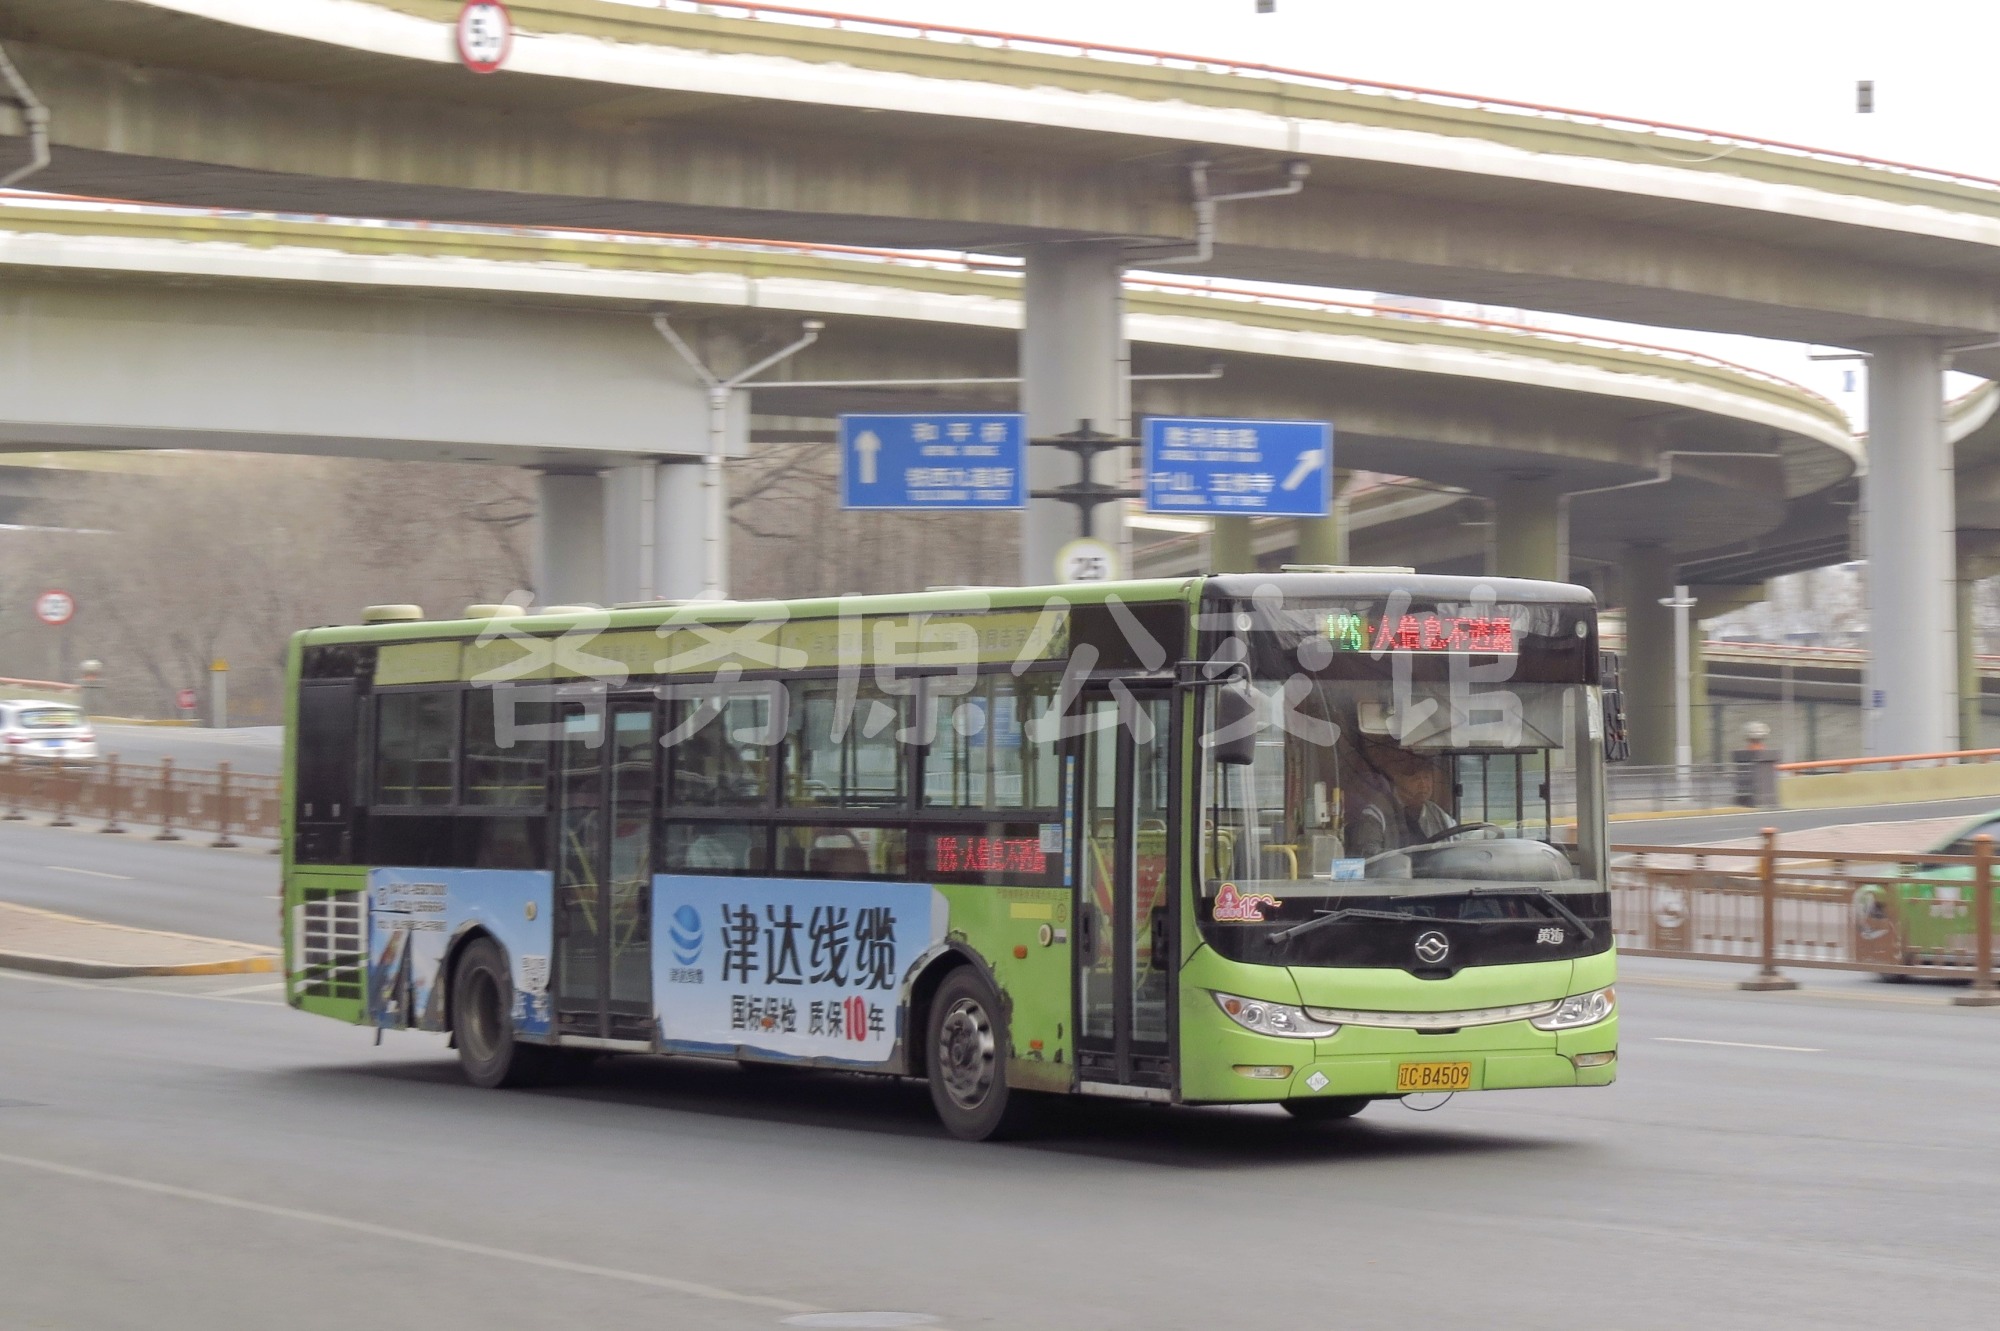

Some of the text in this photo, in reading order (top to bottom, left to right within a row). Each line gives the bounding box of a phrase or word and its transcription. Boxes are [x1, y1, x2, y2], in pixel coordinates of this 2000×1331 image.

[1071, 557, 1106, 580] 25
[720, 903, 897, 990] 津达线缆
[1536, 927, 1564, 945] 黄海
[809, 996, 885, 1042] 质保10年
